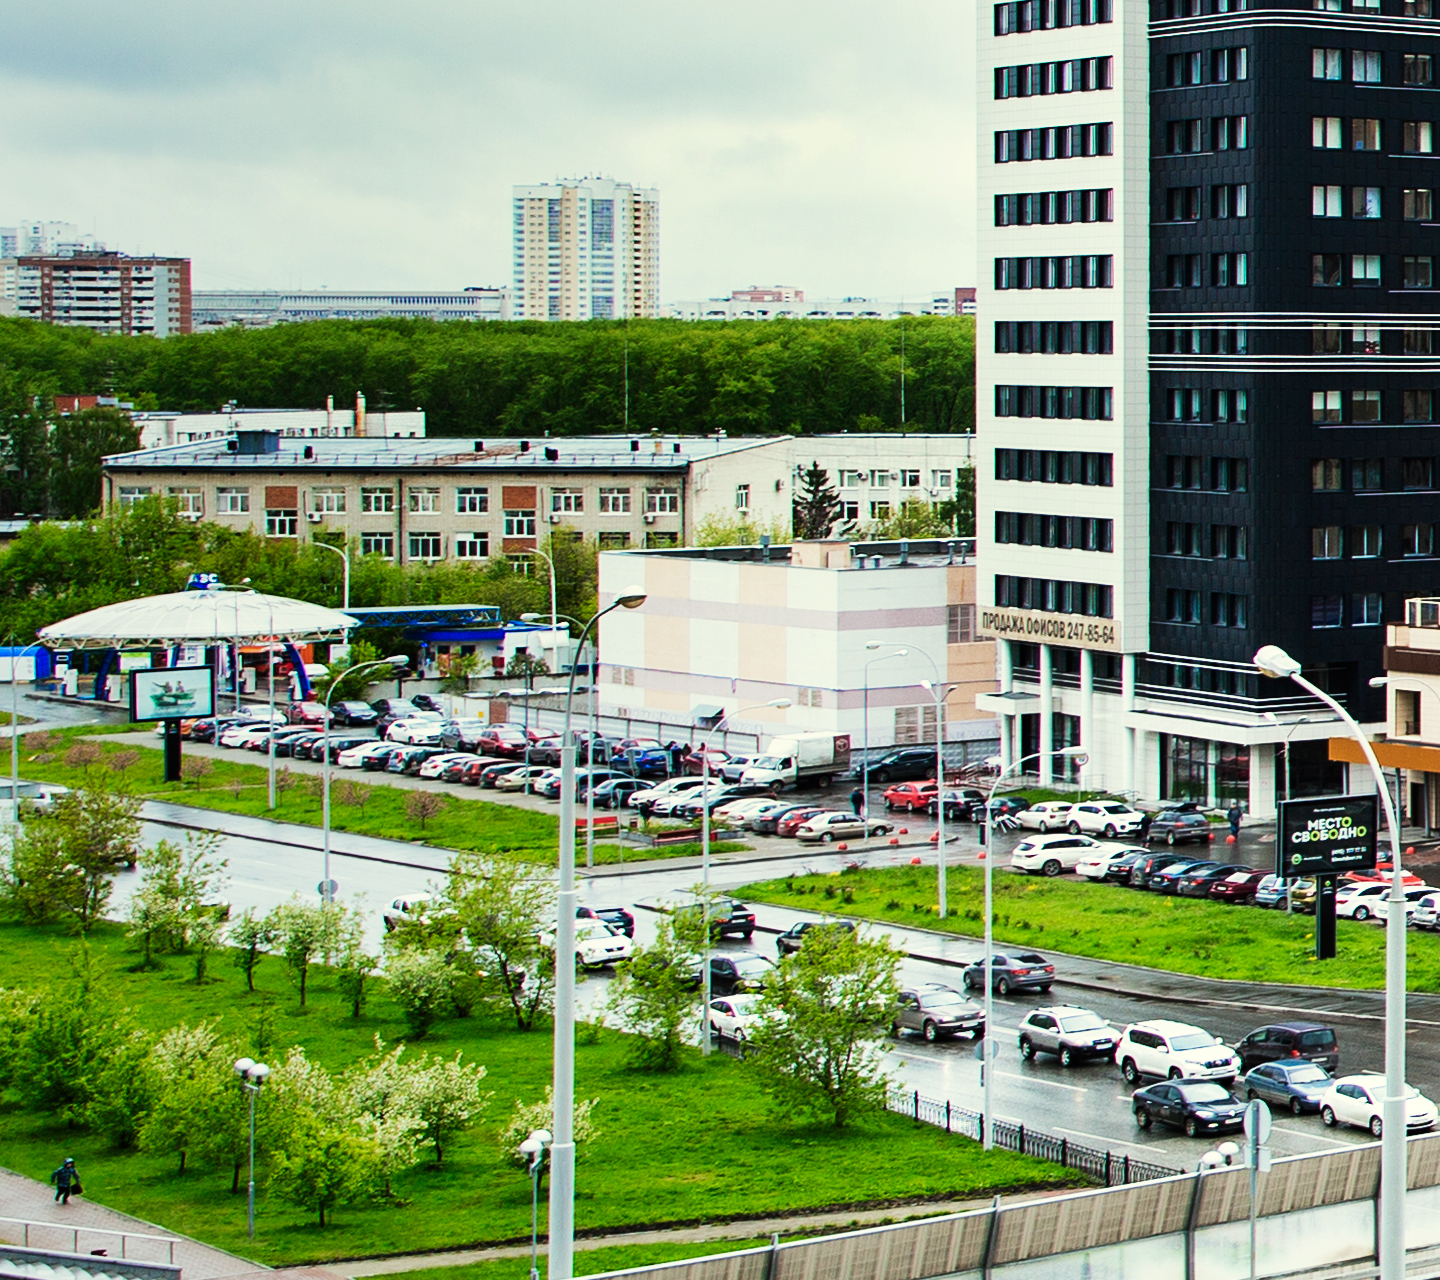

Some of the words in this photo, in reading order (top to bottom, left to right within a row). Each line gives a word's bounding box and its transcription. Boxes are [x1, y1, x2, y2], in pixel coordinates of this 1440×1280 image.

[982, 611, 1025, 634] ПРОДАЖА
[1026, 617, 1066, 639] ОФИСОВ
[1067, 622, 1115, 644] 247-85-64
[1307, 816, 1352, 831] МЕСТО
[1291, 826, 1367, 843] СВОБОДНО
